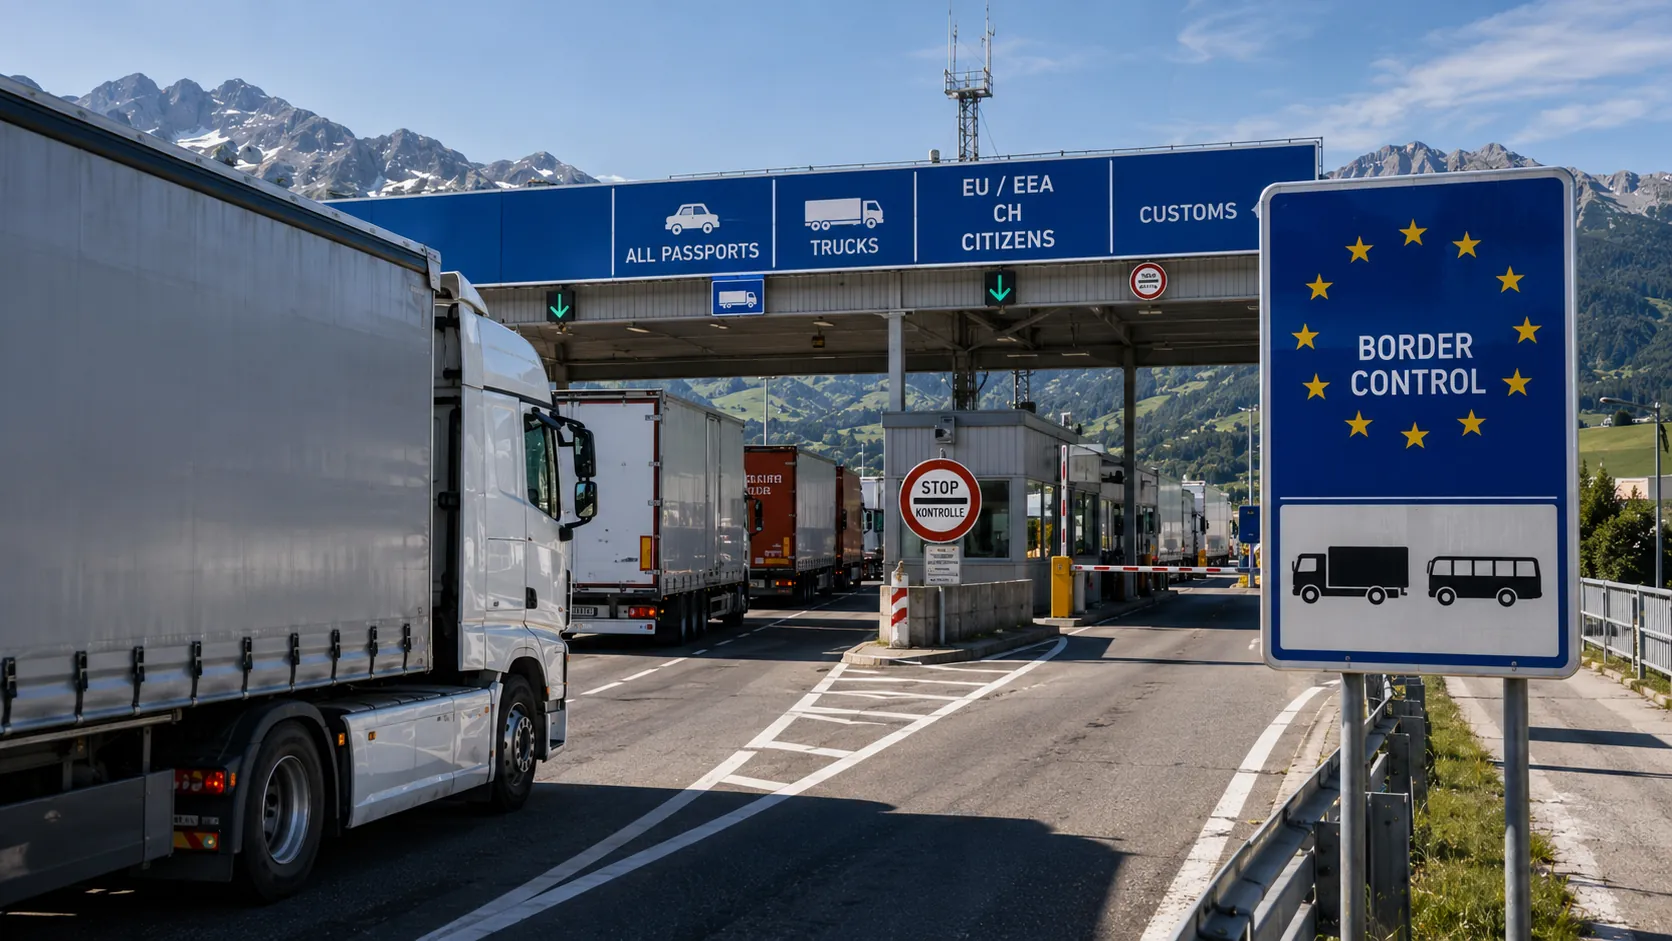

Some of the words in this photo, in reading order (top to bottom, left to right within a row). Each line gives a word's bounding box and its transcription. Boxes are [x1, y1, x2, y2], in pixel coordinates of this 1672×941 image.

[963, 178, 989, 197] EU
[996, 176, 1007, 196] /
[1013, 174, 1054, 194] EEA
[993, 204, 1022, 223] CH
[1139, 202, 1237, 224] CUSTOMS
[811, 237, 879, 256] TRUCKS
[961, 229, 1055, 251] CITIZENS
[625, 248, 656, 264] ALL
[661, 243, 760, 262] PASSPORTS
[1358, 333, 1473, 361] BORDER
[1351, 368, 1486, 397] CONTROL
[921, 481, 959, 495] STOP
[915, 508, 965, 518] KONTROLLE
